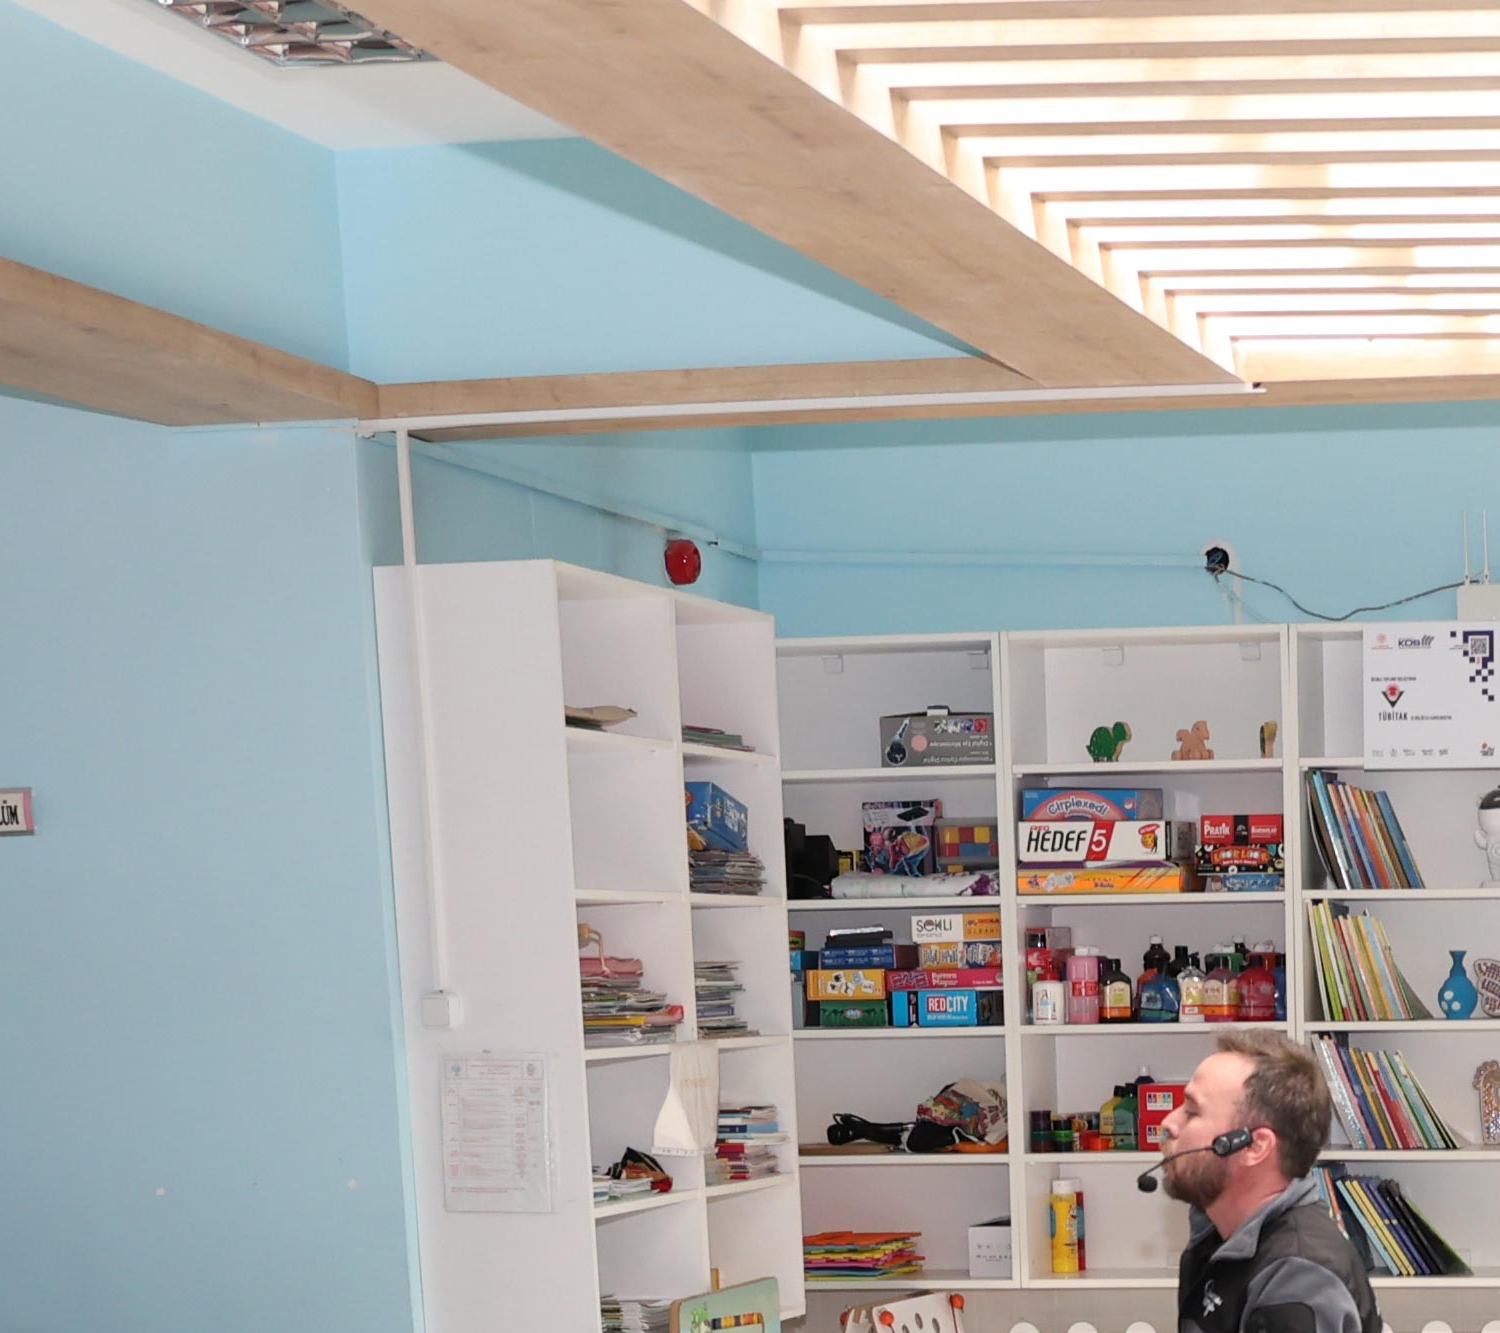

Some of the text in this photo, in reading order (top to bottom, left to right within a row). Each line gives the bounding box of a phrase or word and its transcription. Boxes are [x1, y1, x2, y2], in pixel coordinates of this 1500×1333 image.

[1378, 710, 1408, 721] TÜBİTAK
[1026, 829, 1107, 853] HEDEF 5
